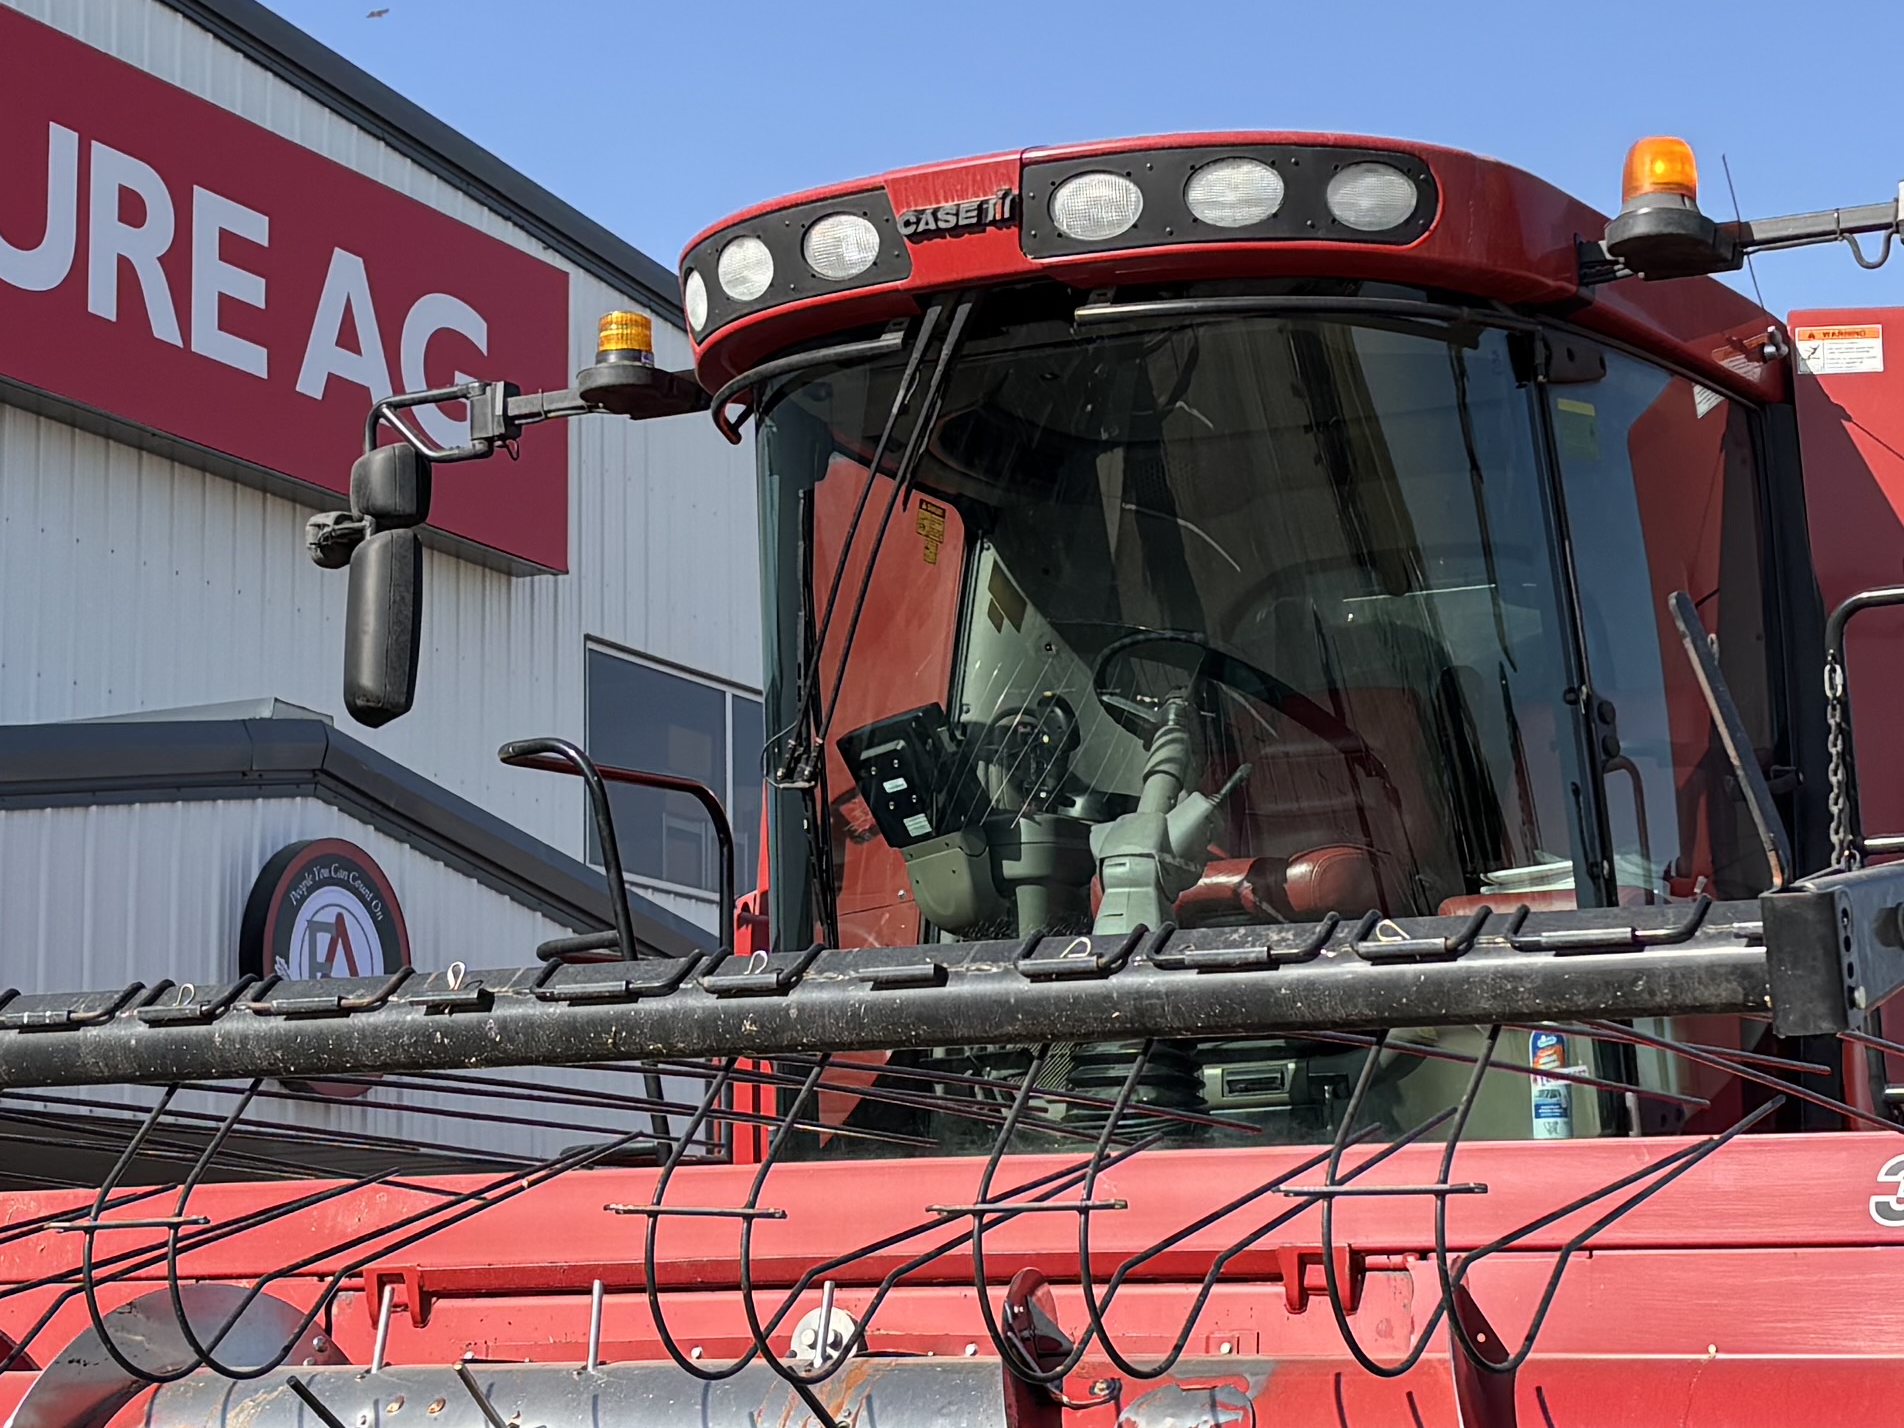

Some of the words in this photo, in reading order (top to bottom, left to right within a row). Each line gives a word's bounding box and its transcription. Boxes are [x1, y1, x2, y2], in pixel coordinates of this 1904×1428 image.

[897, 204, 980, 235] CASE
[295, 246, 488, 446] AG
[289, 872, 313, 906] People
[313, 866, 330, 881] You
[331, 863, 348, 879] Can
[349, 872, 374, 902] Count
[371, 900, 384, 921] On
